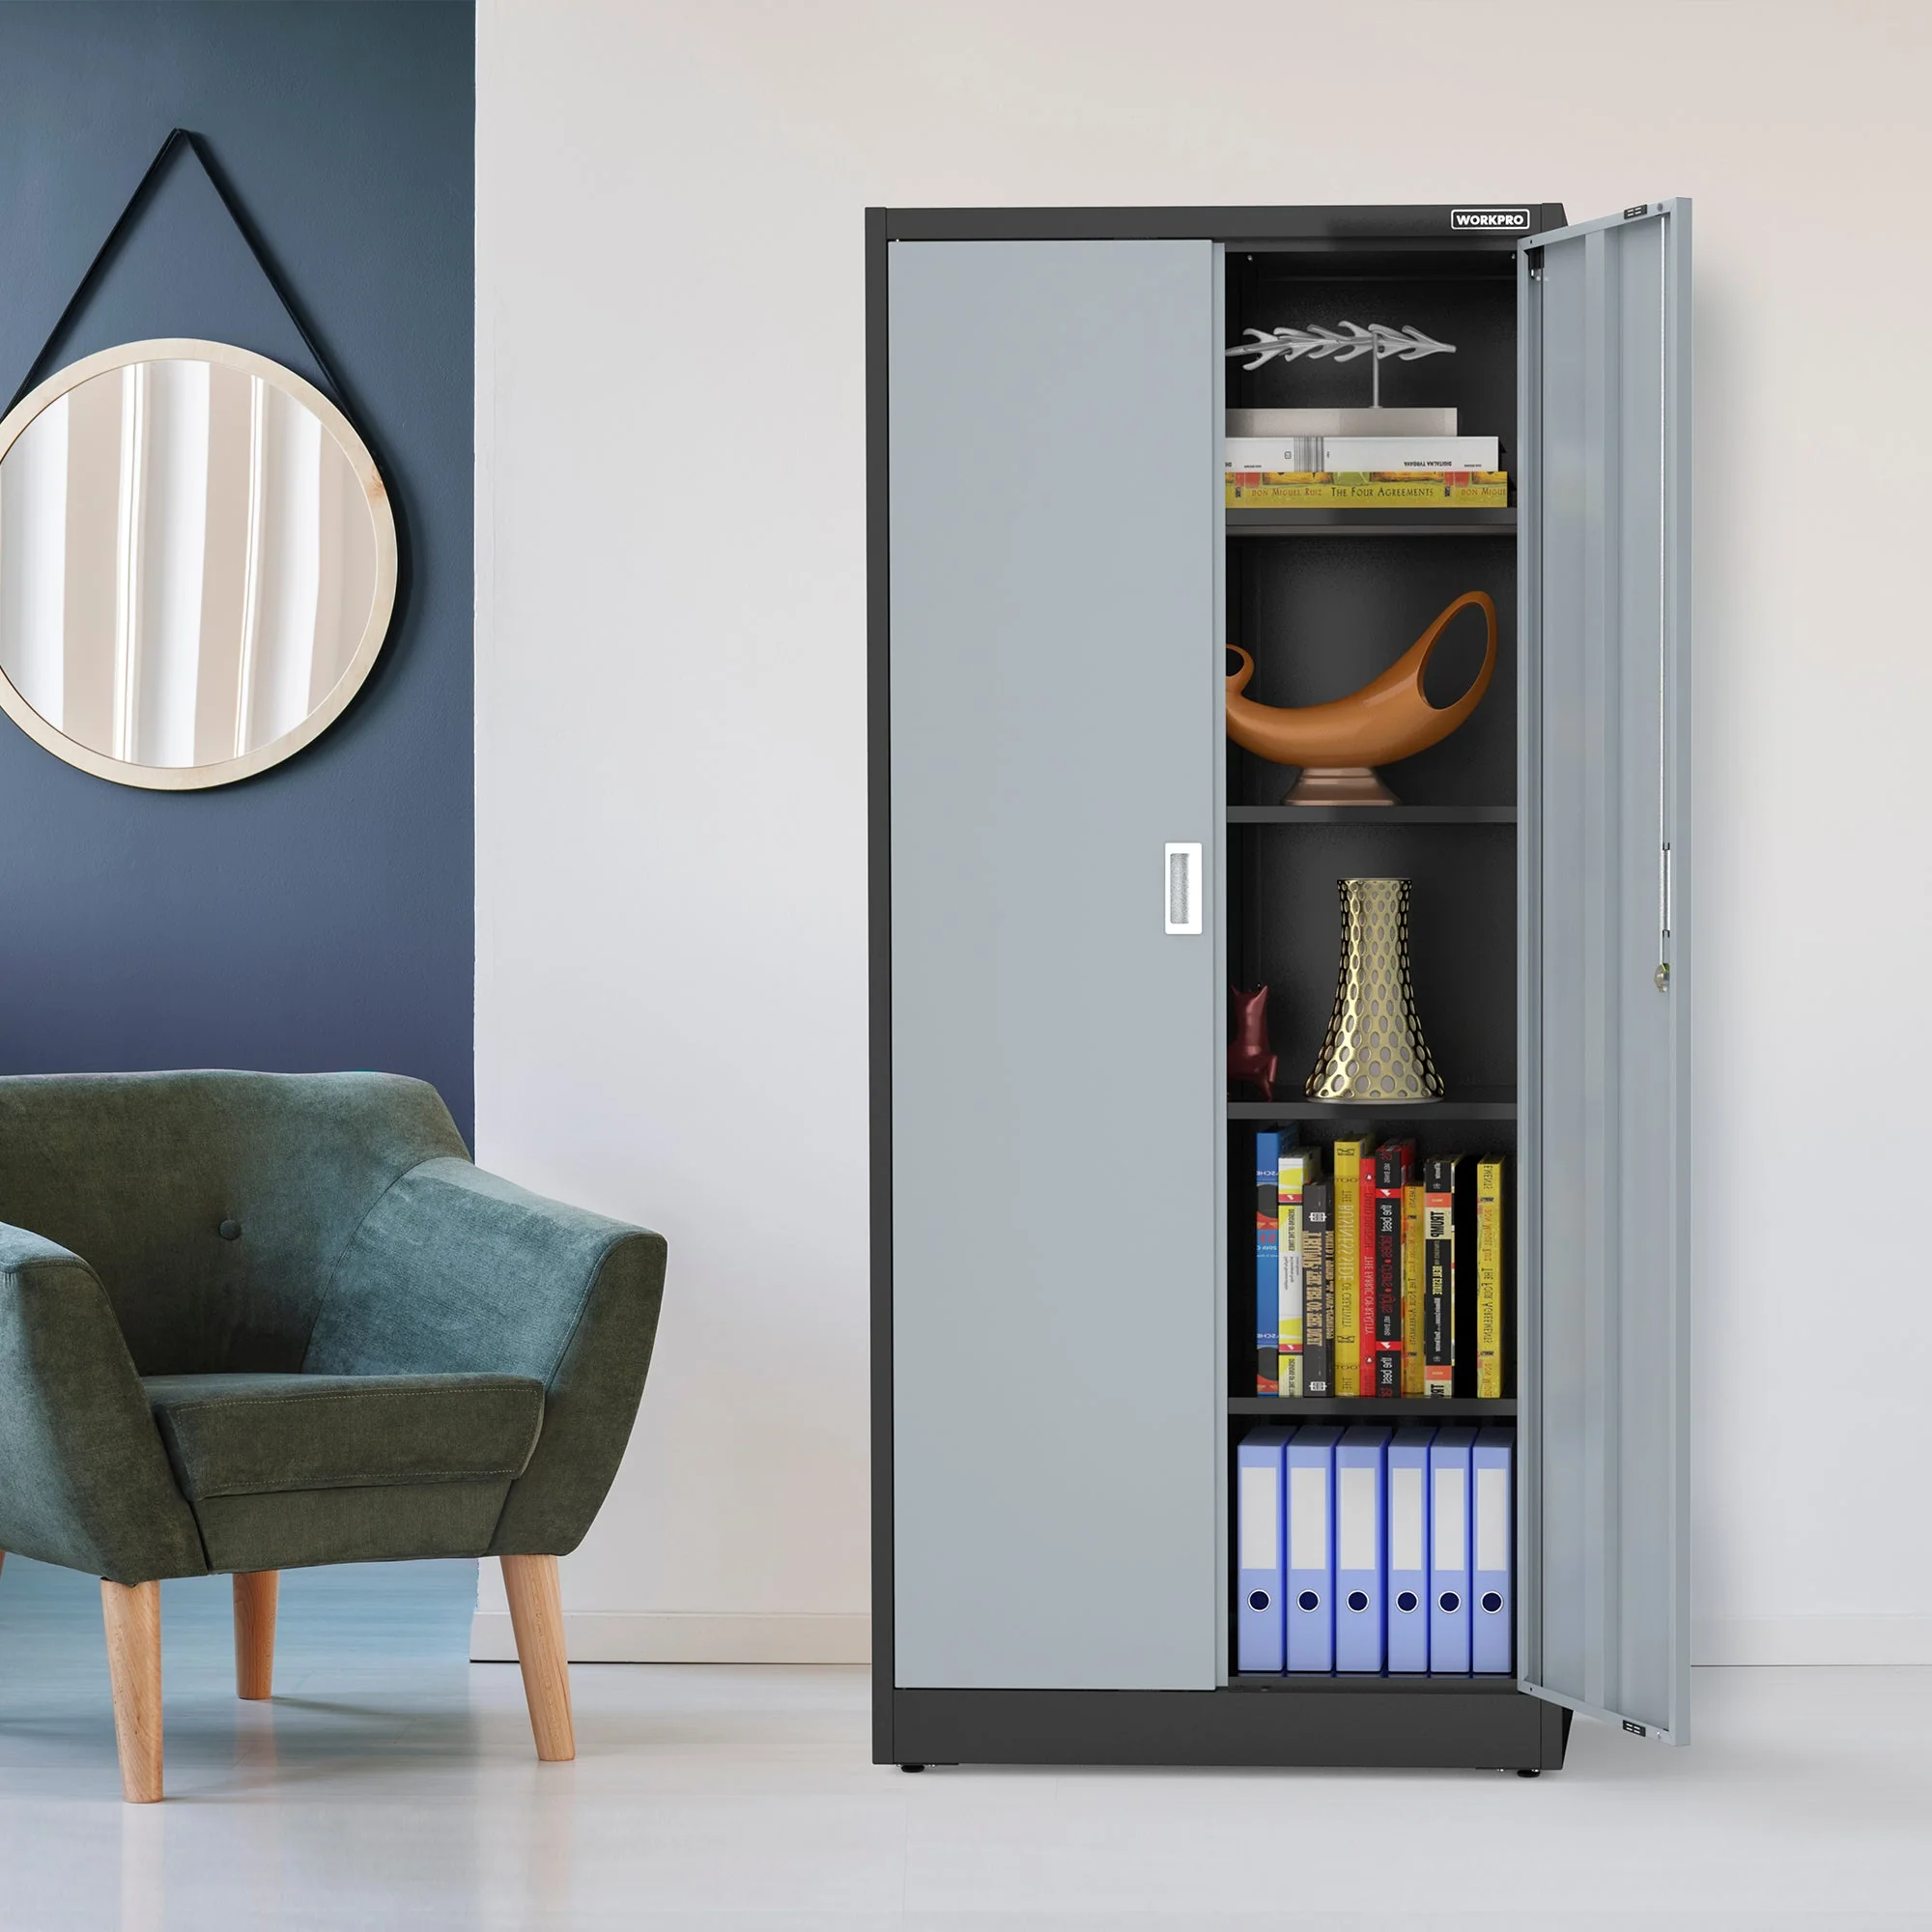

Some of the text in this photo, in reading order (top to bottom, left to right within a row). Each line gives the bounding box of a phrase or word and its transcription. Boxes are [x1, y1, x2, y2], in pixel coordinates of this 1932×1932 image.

[1456, 214, 1524, 226] WORKPRO
[1271, 488, 1300, 497] MIGUEL
[1305, 488, 1322, 497] RUIZ
[1331, 487, 1348, 497] THE
[1351, 487, 1373, 497] FOUR
[1378, 487, 1434, 497] AGREEMENTS
